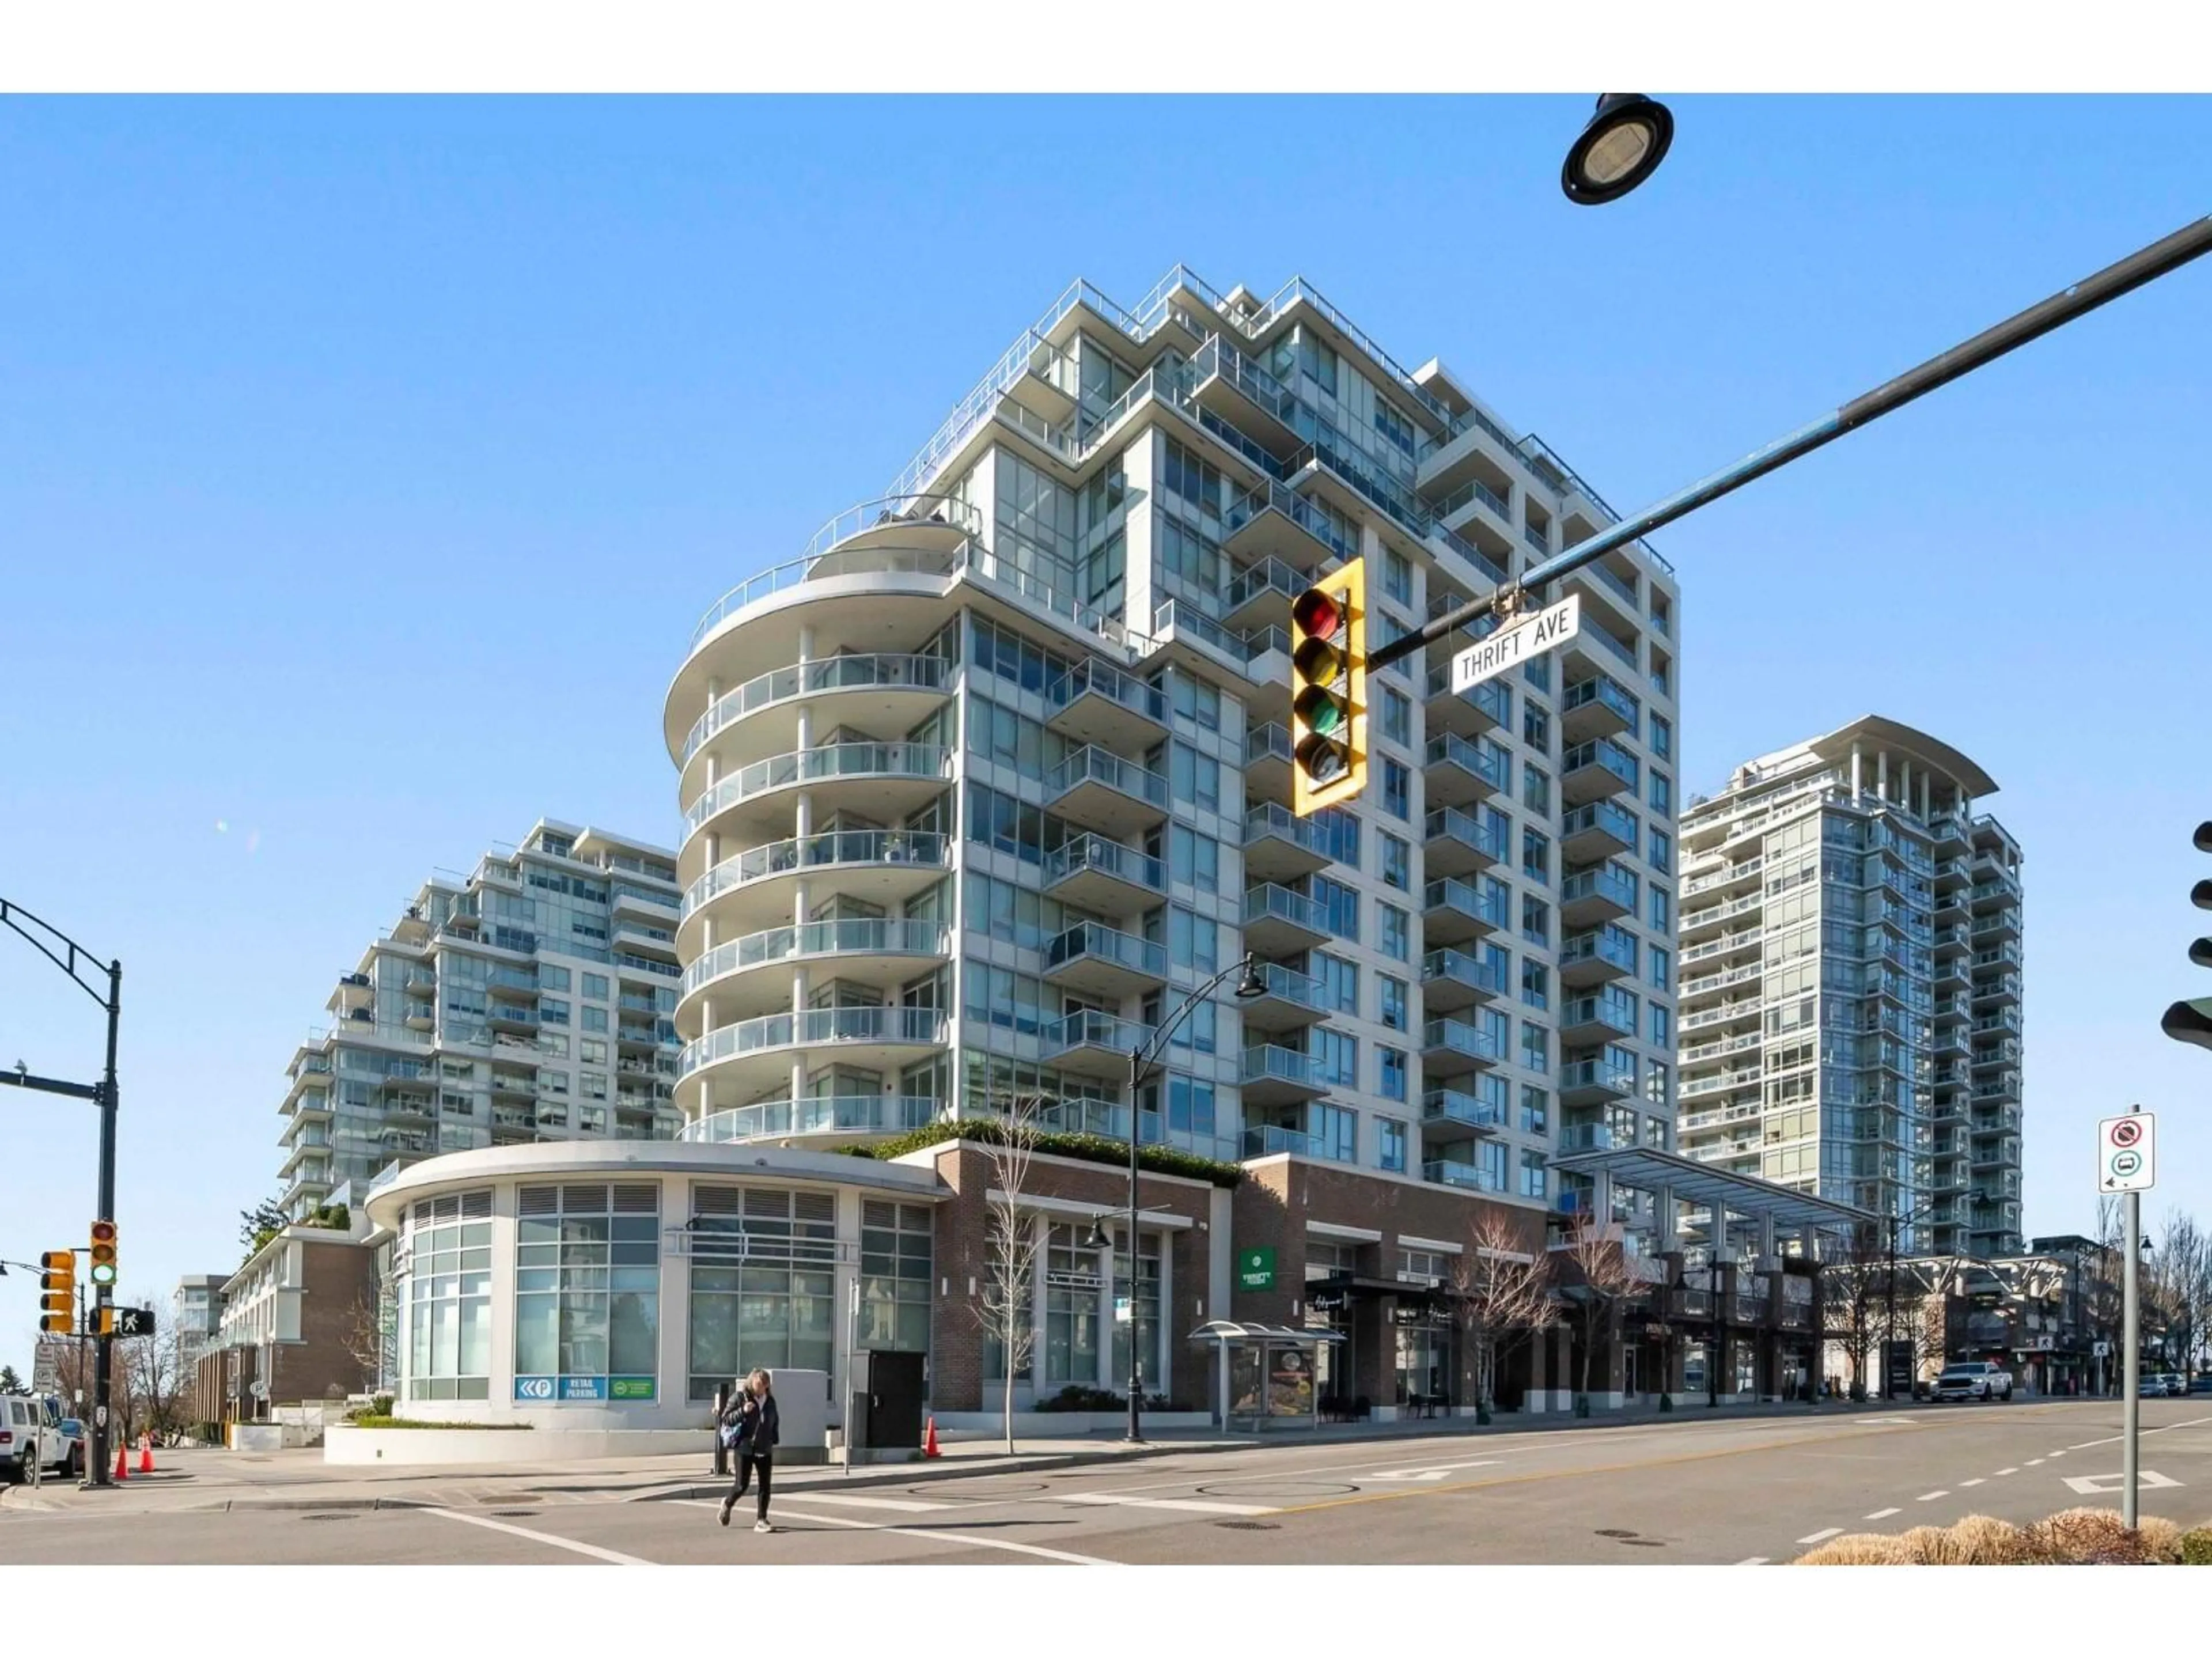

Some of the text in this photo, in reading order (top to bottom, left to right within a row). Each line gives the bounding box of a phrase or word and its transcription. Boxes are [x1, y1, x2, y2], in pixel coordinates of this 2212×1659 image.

[1461, 607, 1570, 680] THRIFT AVE
[540, 1382, 547, 1395] P
[566, 1389, 598, 1399] PARKING
